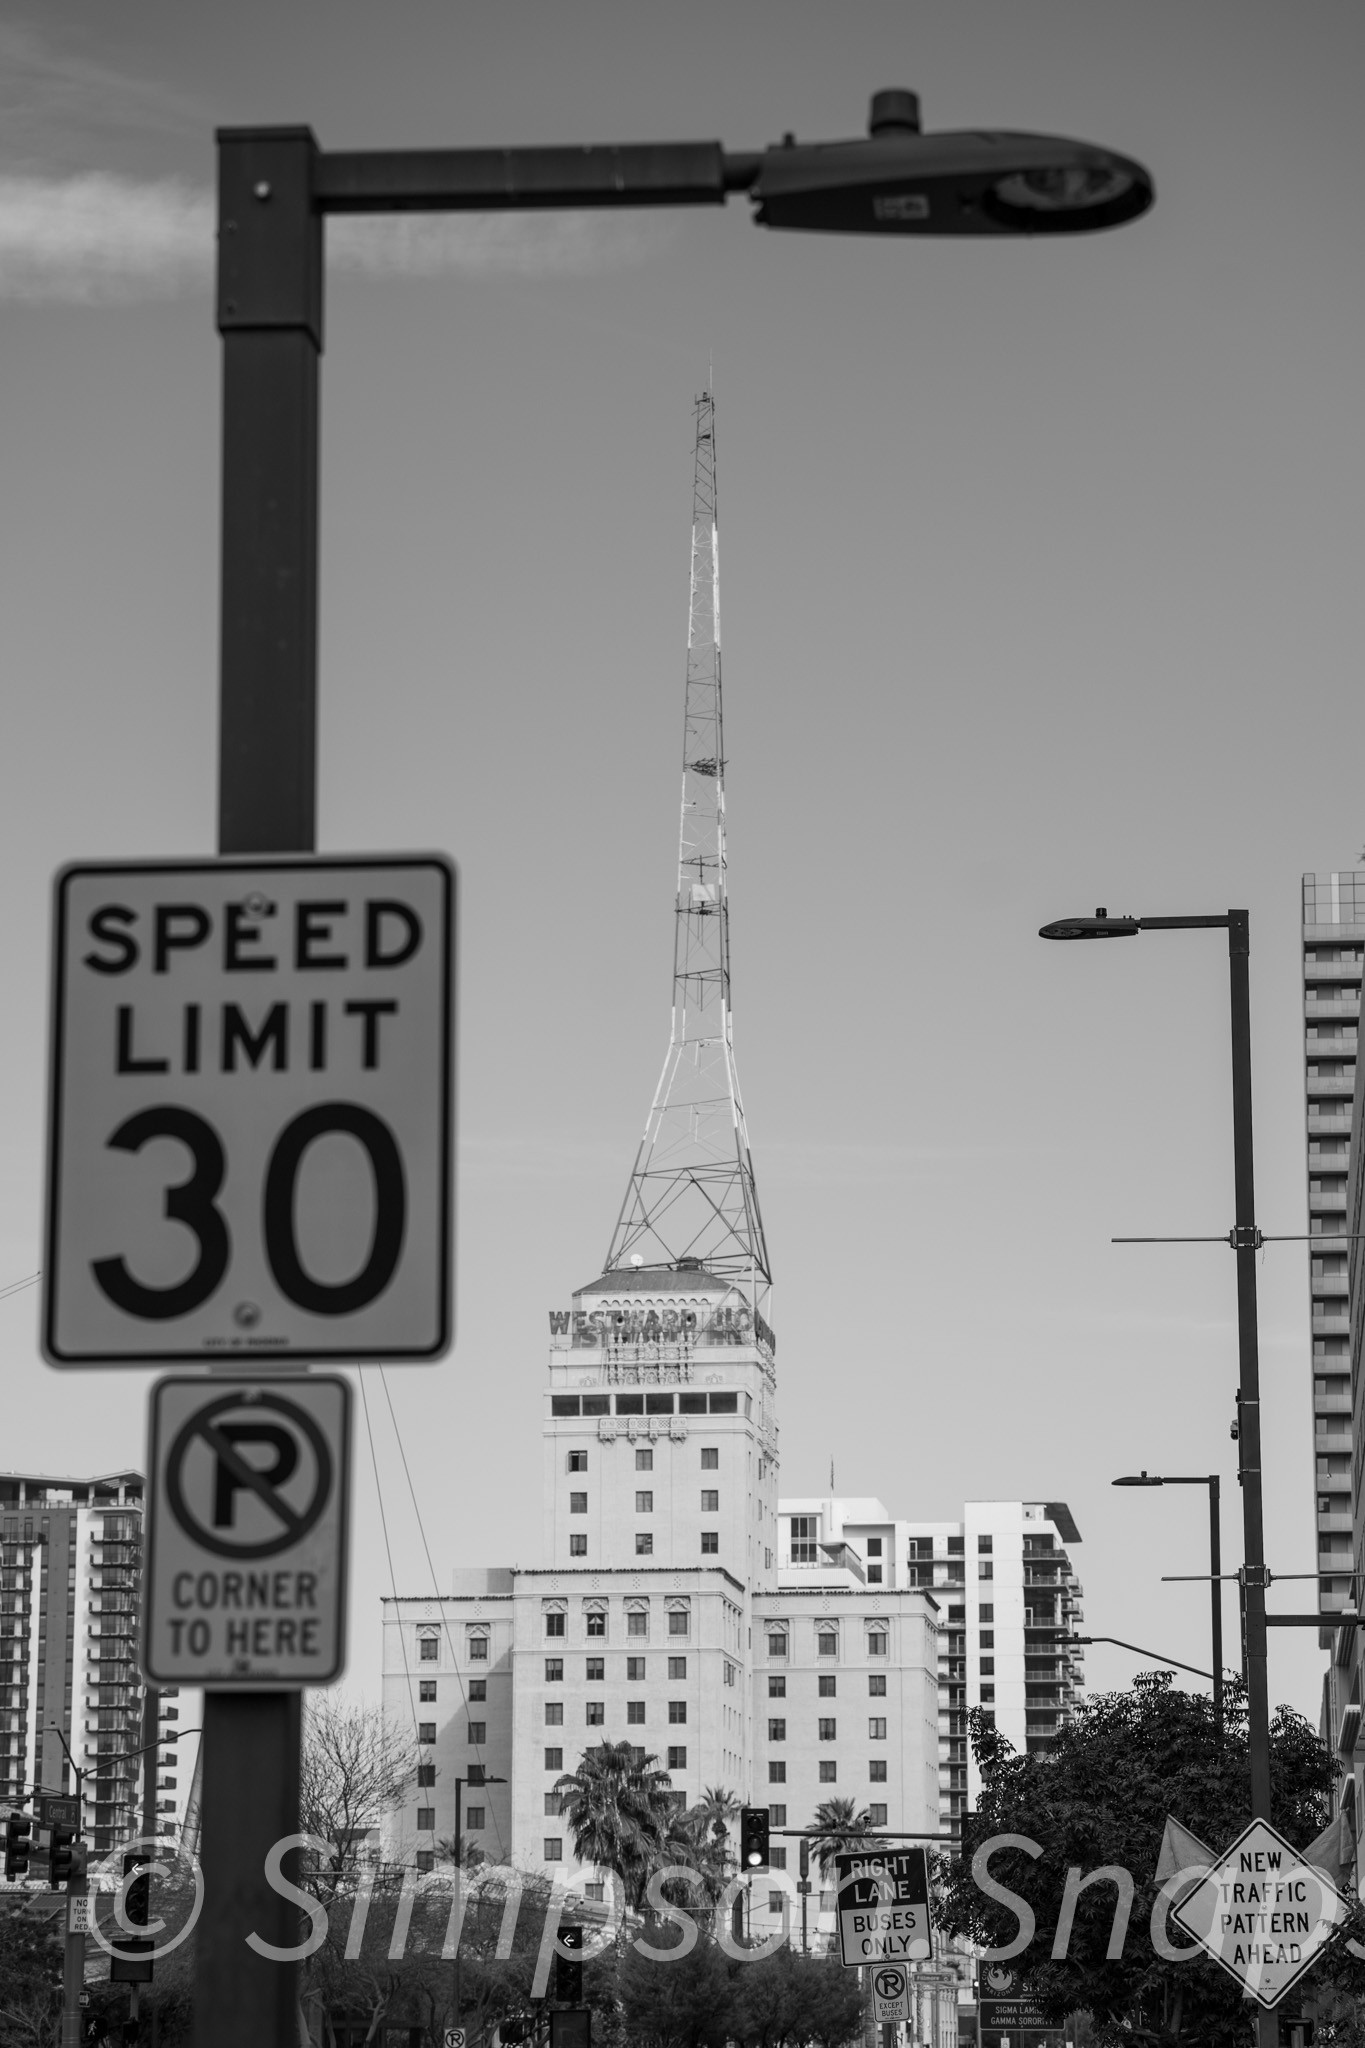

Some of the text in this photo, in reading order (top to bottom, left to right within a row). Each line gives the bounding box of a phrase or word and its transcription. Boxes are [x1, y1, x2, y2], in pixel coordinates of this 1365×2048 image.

[83, 899, 424, 975] SPEED
[114, 1000, 399, 1075] LIMIT
[89, 1101, 408, 1323] 30
[549, 1310, 697, 1335] WESTWARD
[715, 1307, 754, 1332] HO
[172, 1571, 318, 1611] CORNER
[168, 1617, 321, 1658] TO HERE
[850, 1855, 910, 1879] RIGHT
[1240, 1851, 1282, 1873] NEW
[854, 1880, 911, 1903] LANE
[1220, 1881, 1307, 1903] TRAFFIC
[76, 1898, 89, 1908] NO
[74, 1923, 89, 1931] RED
[853, 1911, 916, 1933] BUSES
[1220, 1912, 1310, 1934] PATTERN
[861, 1935, 911, 1956] ONLY
[1233, 1943, 1302, 1965] AHEAD
[985, 1986, 1015, 1997] ARIZONA
[879, 2001, 904, 2010] EXCEPT
[881, 2009, 903, 2017] BUSES
[995, 2006, 1018, 2014] SIGMA
[990, 2016, 1017, 2025] GAMMA
